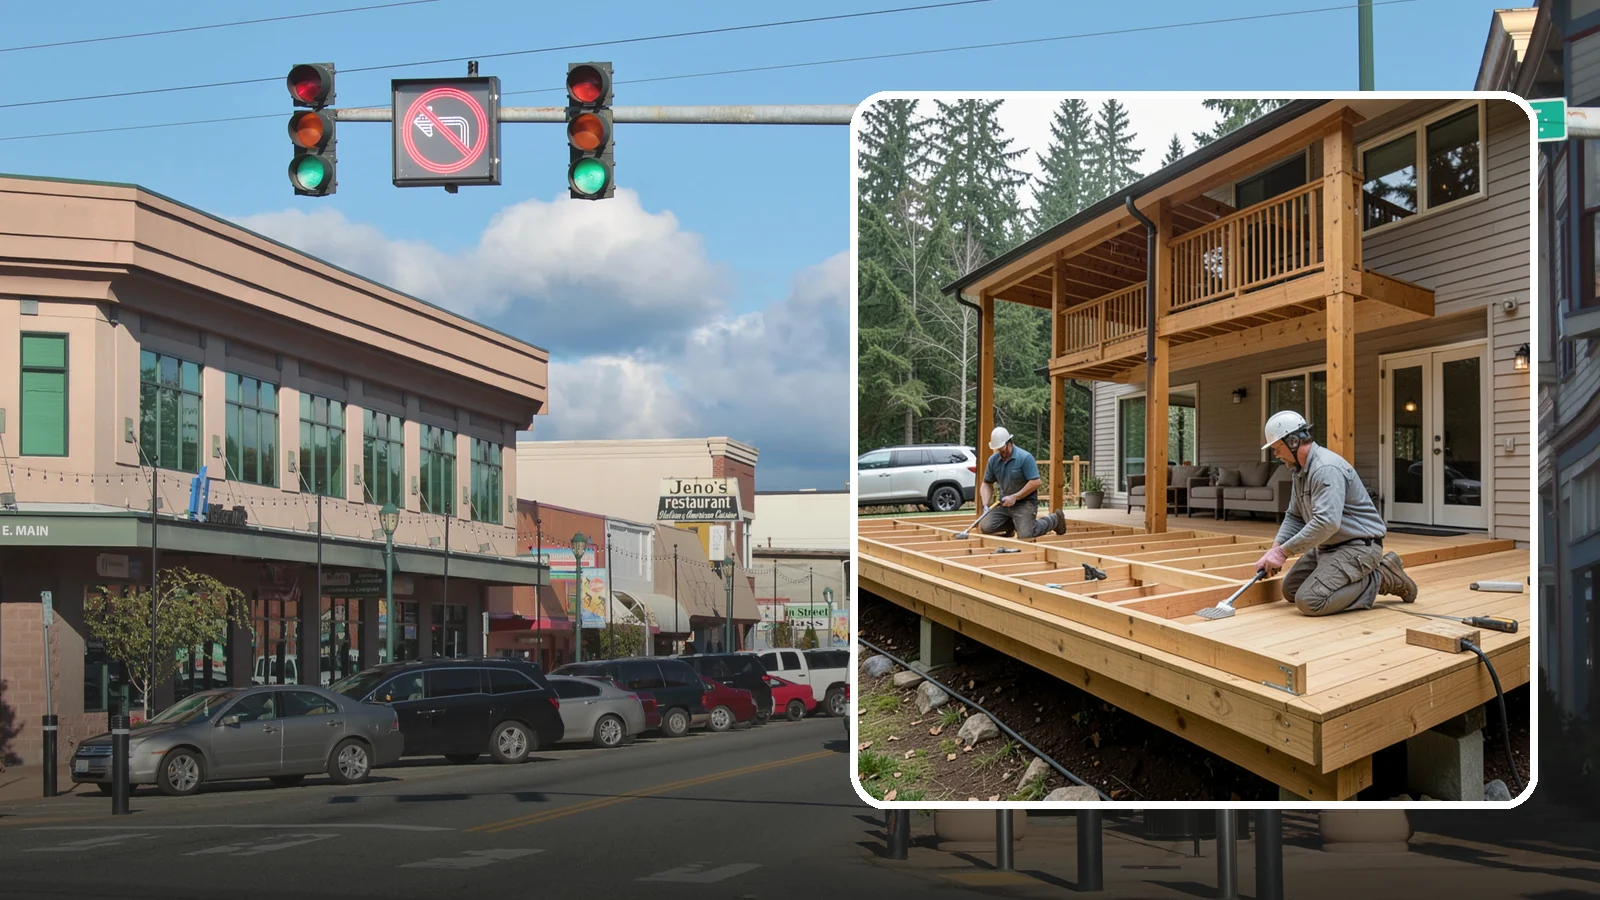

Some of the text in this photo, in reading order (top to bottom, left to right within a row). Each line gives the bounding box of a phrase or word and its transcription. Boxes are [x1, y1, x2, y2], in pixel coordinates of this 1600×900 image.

[669, 480, 728, 495] Jeno's
[665, 496, 731, 509] restaurant
[658, 509, 681, 520] Italian
[686, 509, 714, 519] American
[715, 509, 738, 519] Cuisine
[2, 525, 49, 536] E. MAIN
[797, 608, 828, 617] Street
